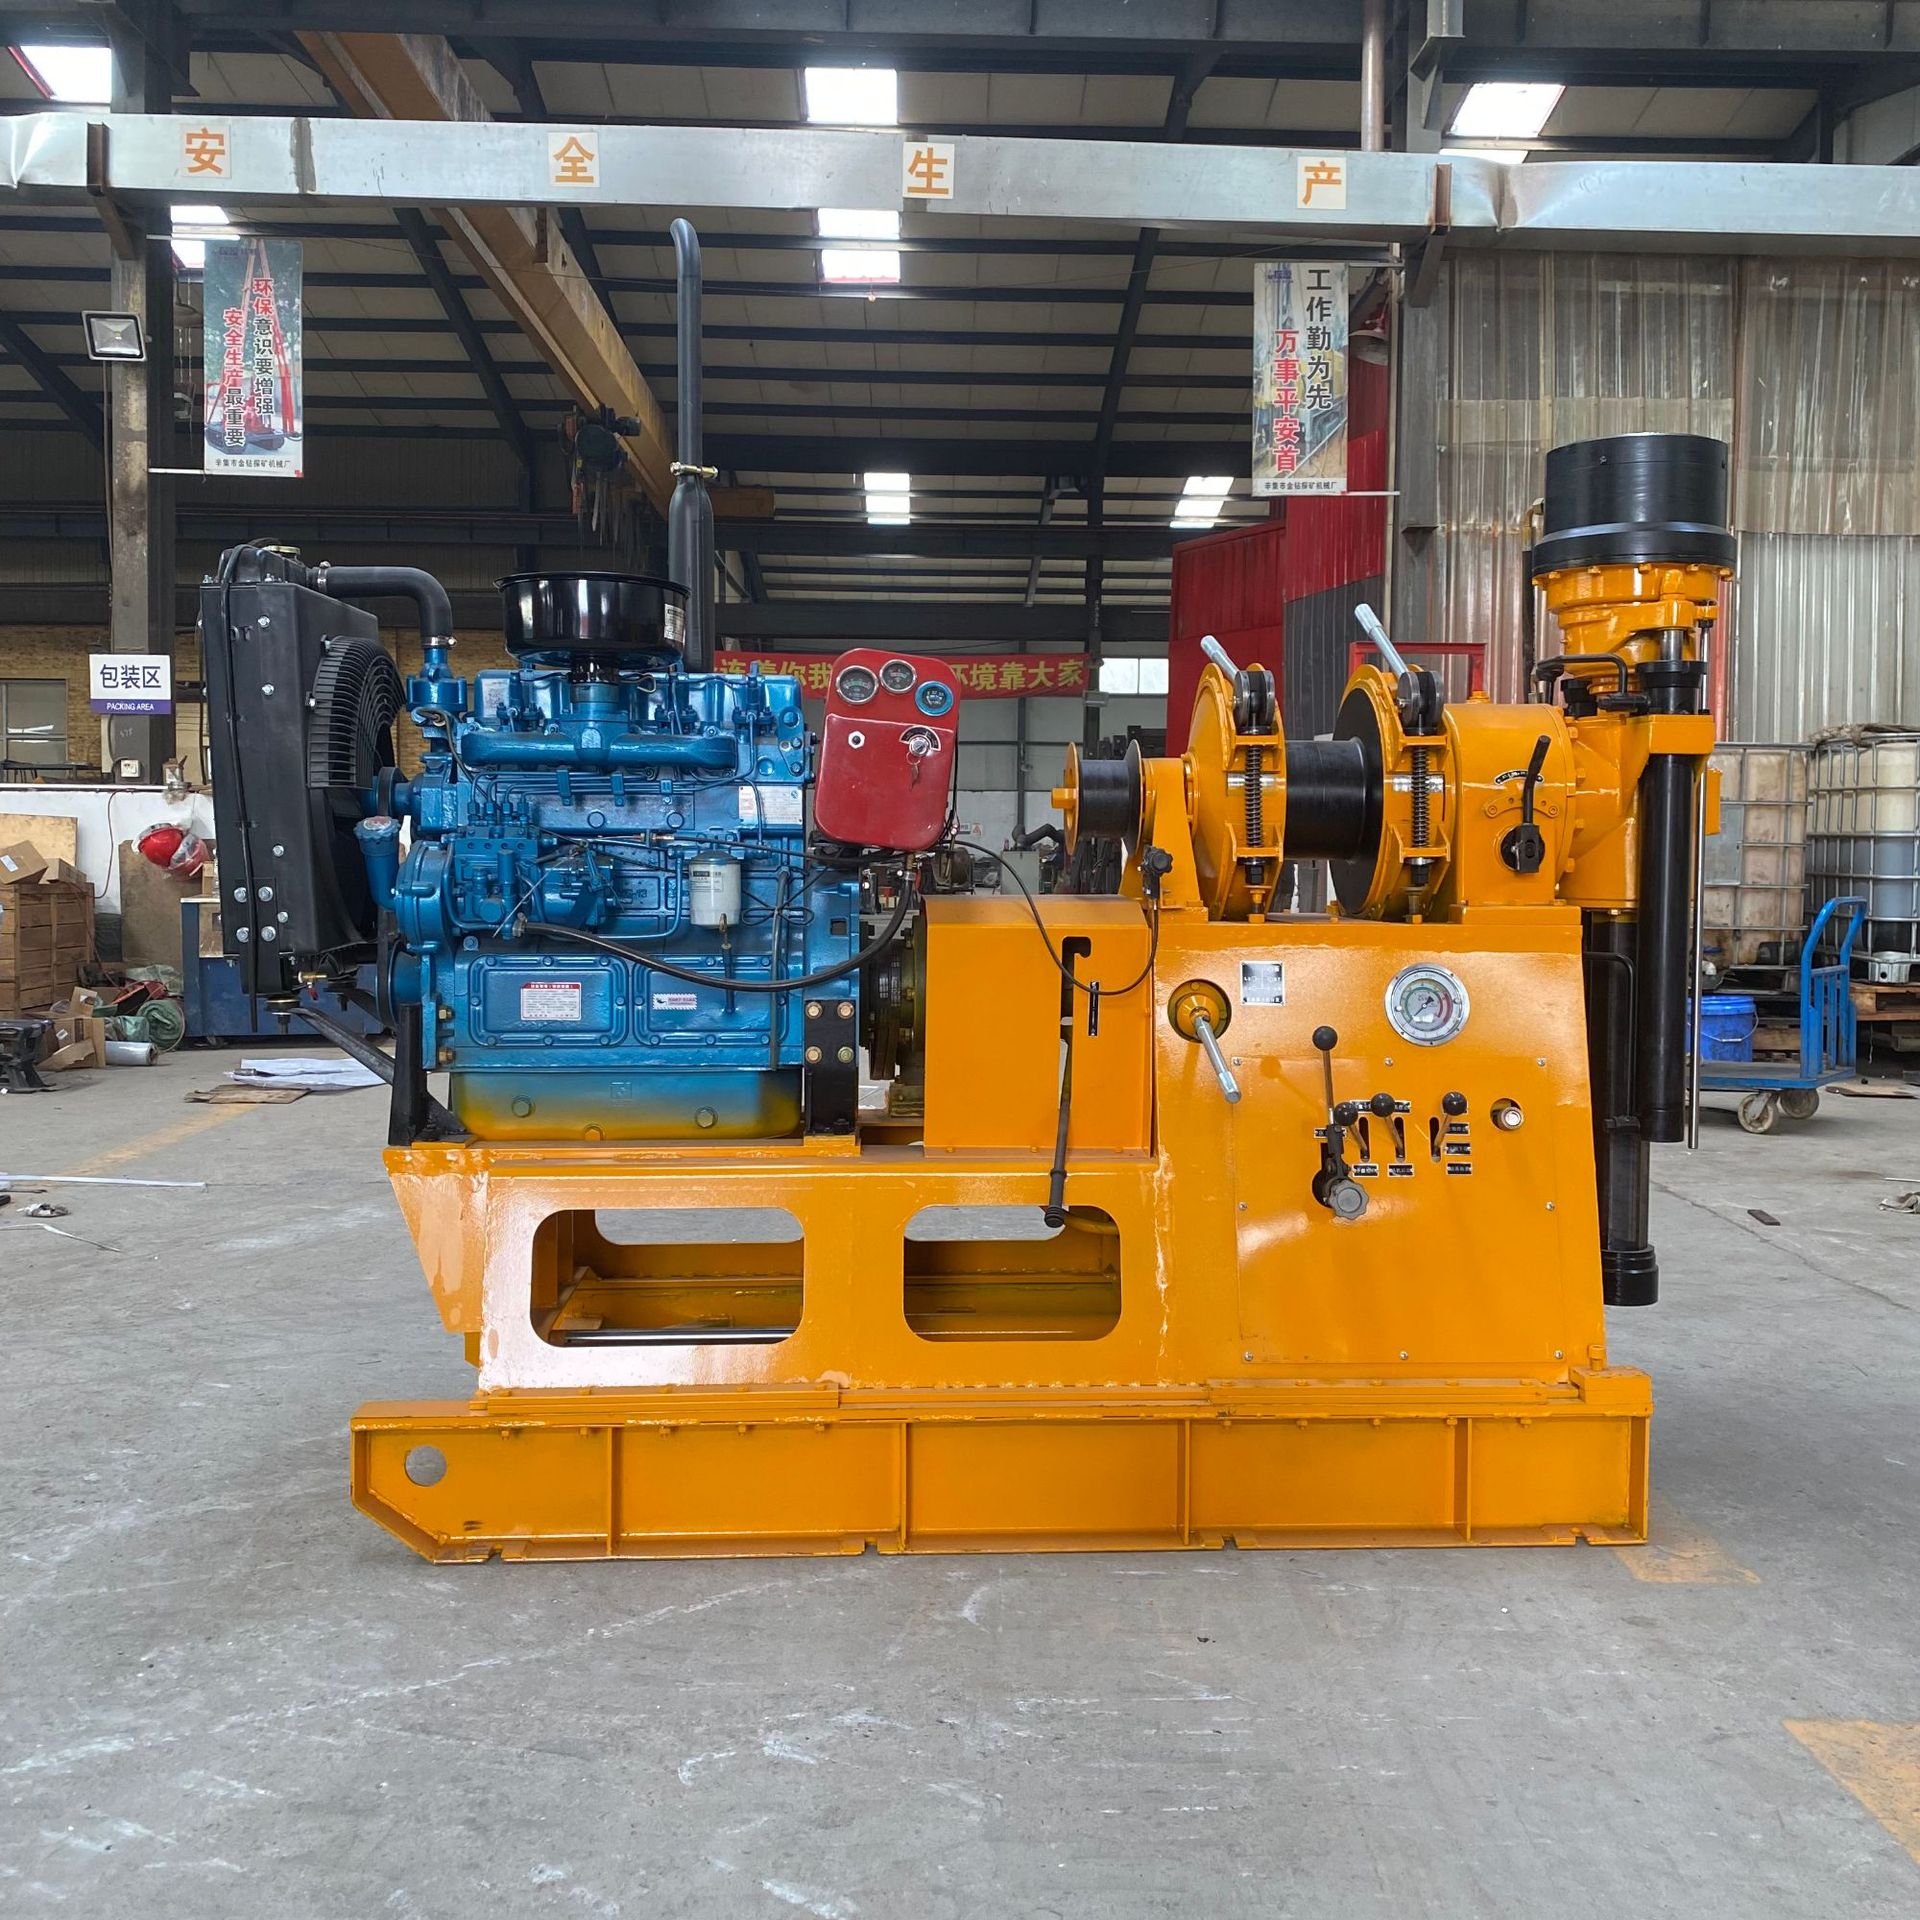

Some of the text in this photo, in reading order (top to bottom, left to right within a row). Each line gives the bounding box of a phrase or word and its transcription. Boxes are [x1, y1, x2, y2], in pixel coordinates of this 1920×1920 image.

[185, 127, 1342, 206] 安 全 生 产
[223, 309, 246, 446] 安全生产最重要
[252, 278, 274, 415] 环保意识要增强
[1273, 329, 1301, 471] 万事平安首
[1306, 269, 1332, 410] 工作勤为先
[99, 664, 162, 689] 包装区
[106, 702, 155, 711] PACKING AREA
